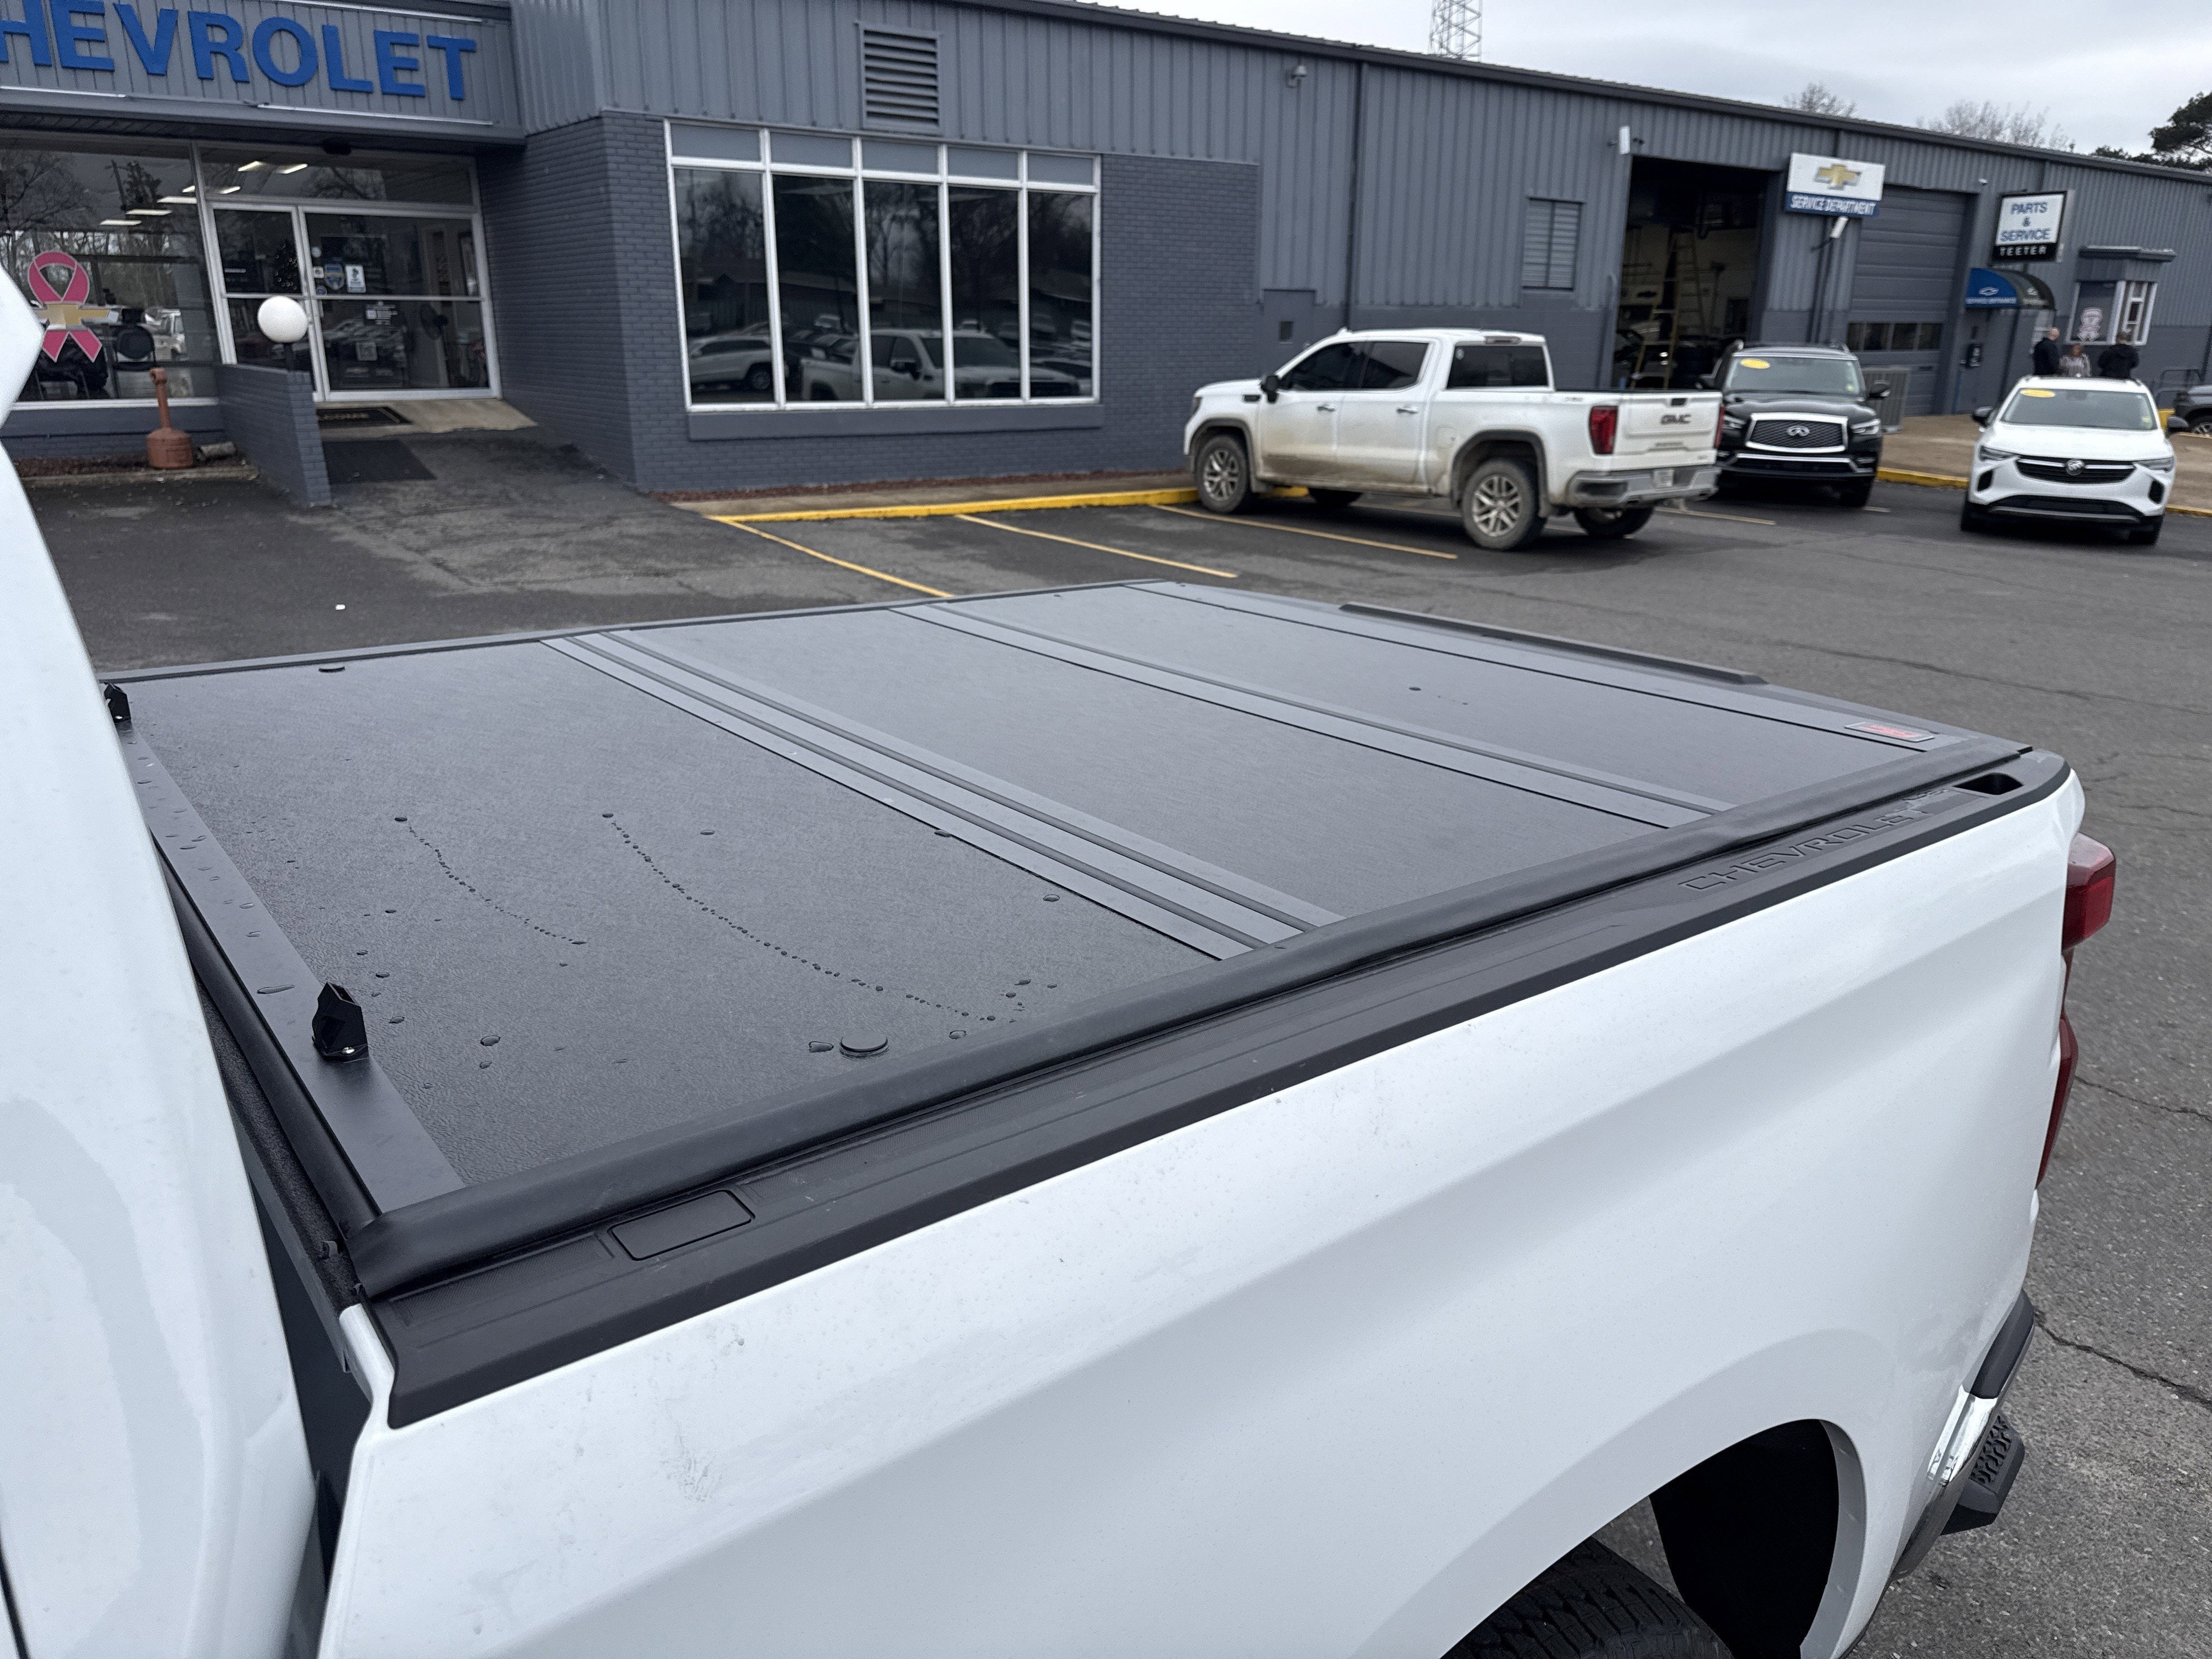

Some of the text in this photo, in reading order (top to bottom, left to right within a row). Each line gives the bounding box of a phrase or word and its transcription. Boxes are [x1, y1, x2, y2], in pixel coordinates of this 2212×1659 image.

[2010, 202, 2048, 215] PARTS
[2022, 216, 2030, 227] &
[2000, 228, 2051, 241] SERVICE
[2000, 245, 2047, 256] TEETER
[1660, 414, 1691, 425] GMC
[1678, 794, 1931, 890] CHEVROLET
